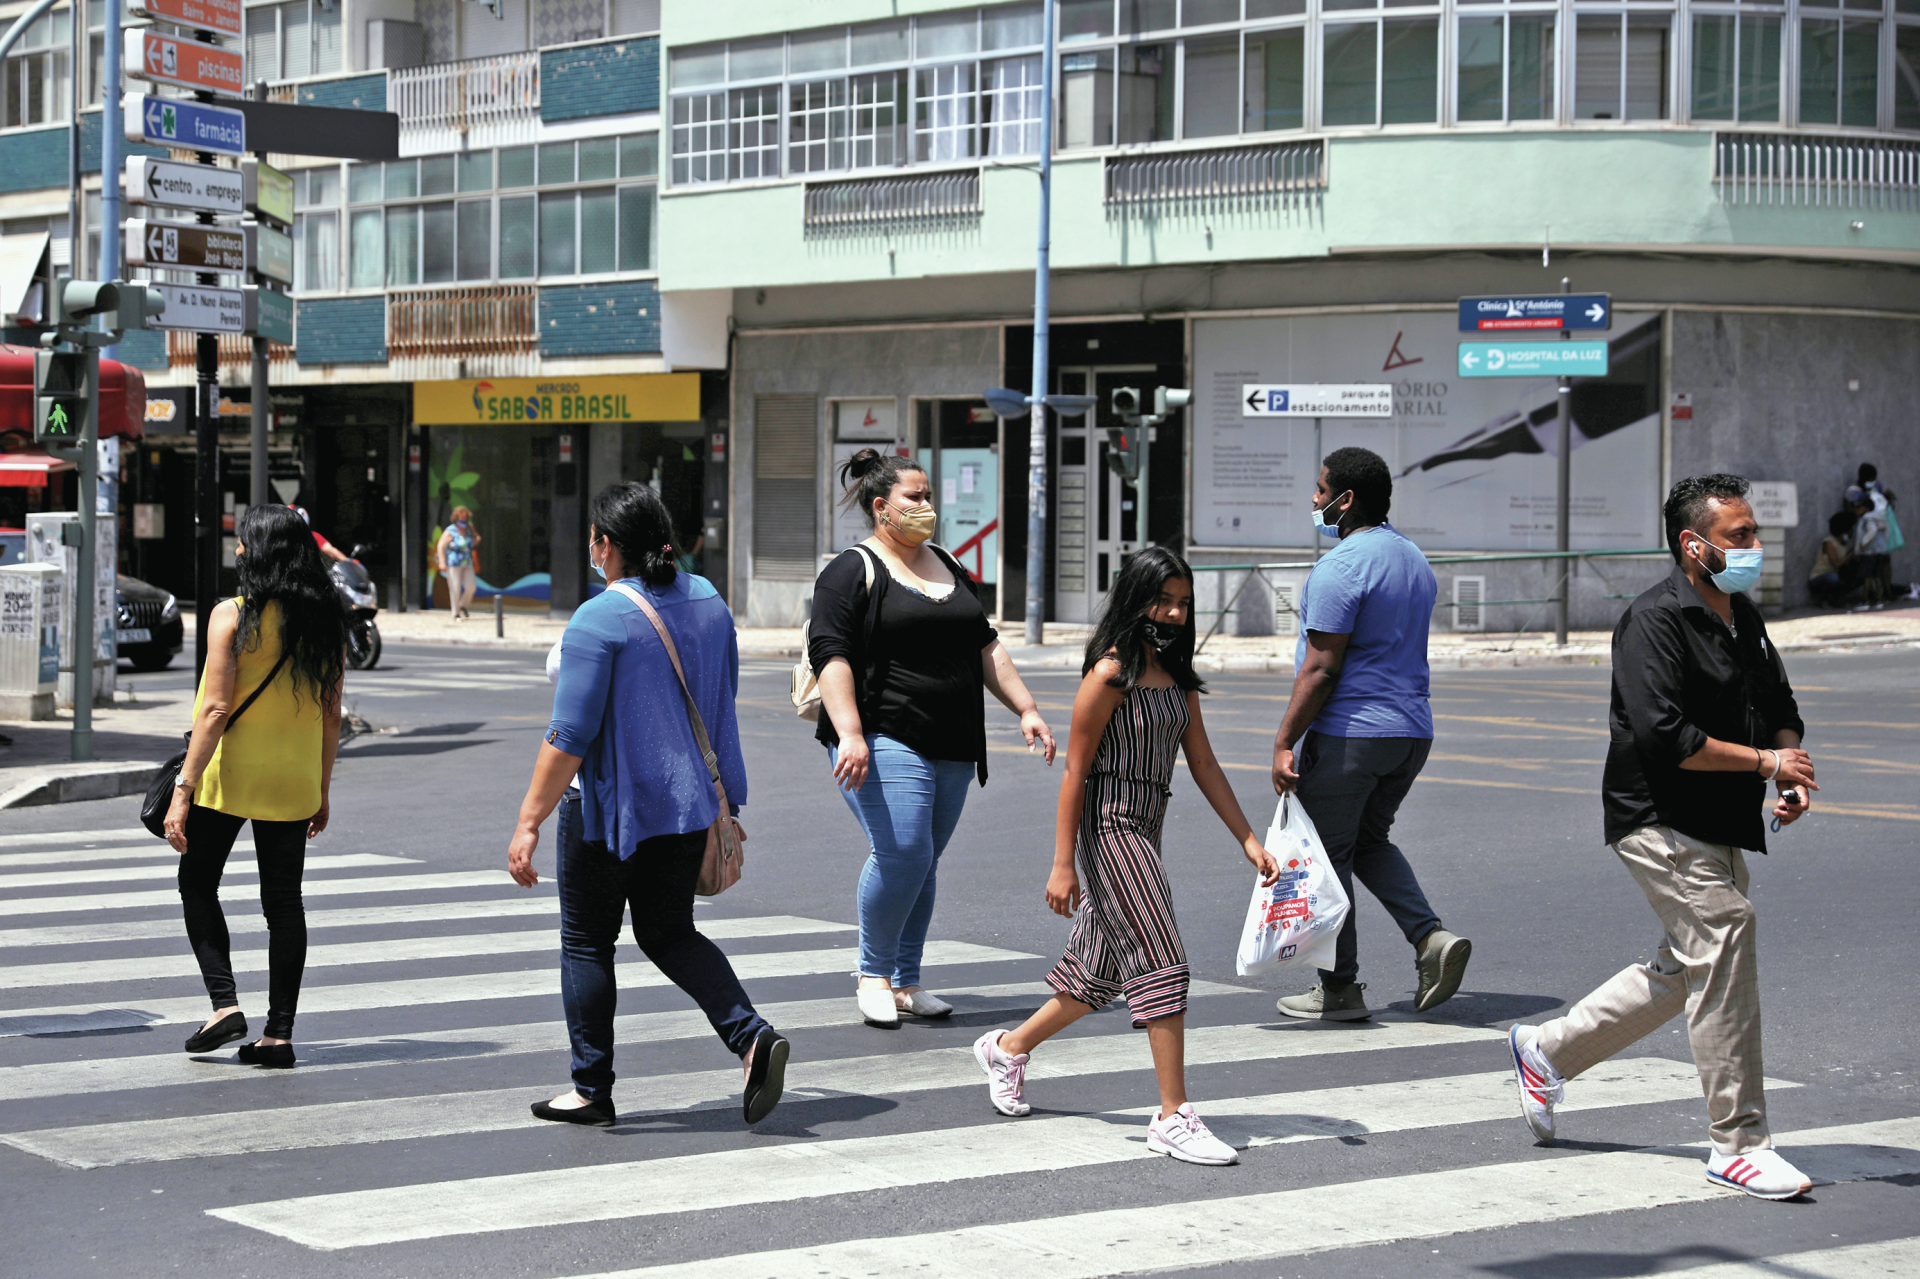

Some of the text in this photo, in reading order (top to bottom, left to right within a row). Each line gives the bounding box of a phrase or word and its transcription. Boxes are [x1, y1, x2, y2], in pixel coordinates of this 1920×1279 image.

[183, 2, 204, 21] Bairro
[215, 10, 239, 29] Janeiro
[198, 60, 241, 84] piscinas
[195, 116, 241, 145] farmácia
[163, 174, 192, 195] centro
[206, 182, 241, 202] emprego
[207, 233, 242, 251] biblioteca
[204, 250, 242, 269] José Régio
[201, 295, 216, 307] Nuno
[1477, 300, 1508, 312] Clínica
[221, 312, 241, 325] Pereira
[1507, 350, 1602, 362] HOSPITAL DA LUZ
[536, 383, 580, 394] MERCADO
[1342, 390, 1389, 399] parque de
[488, 394, 631, 420] SABOR BRASIL
[1291, 402, 1390, 412] estacionamento
[1273, 902, 1305, 911] POUPAMOS
[1274, 909, 1299, 917] PLANETA.
